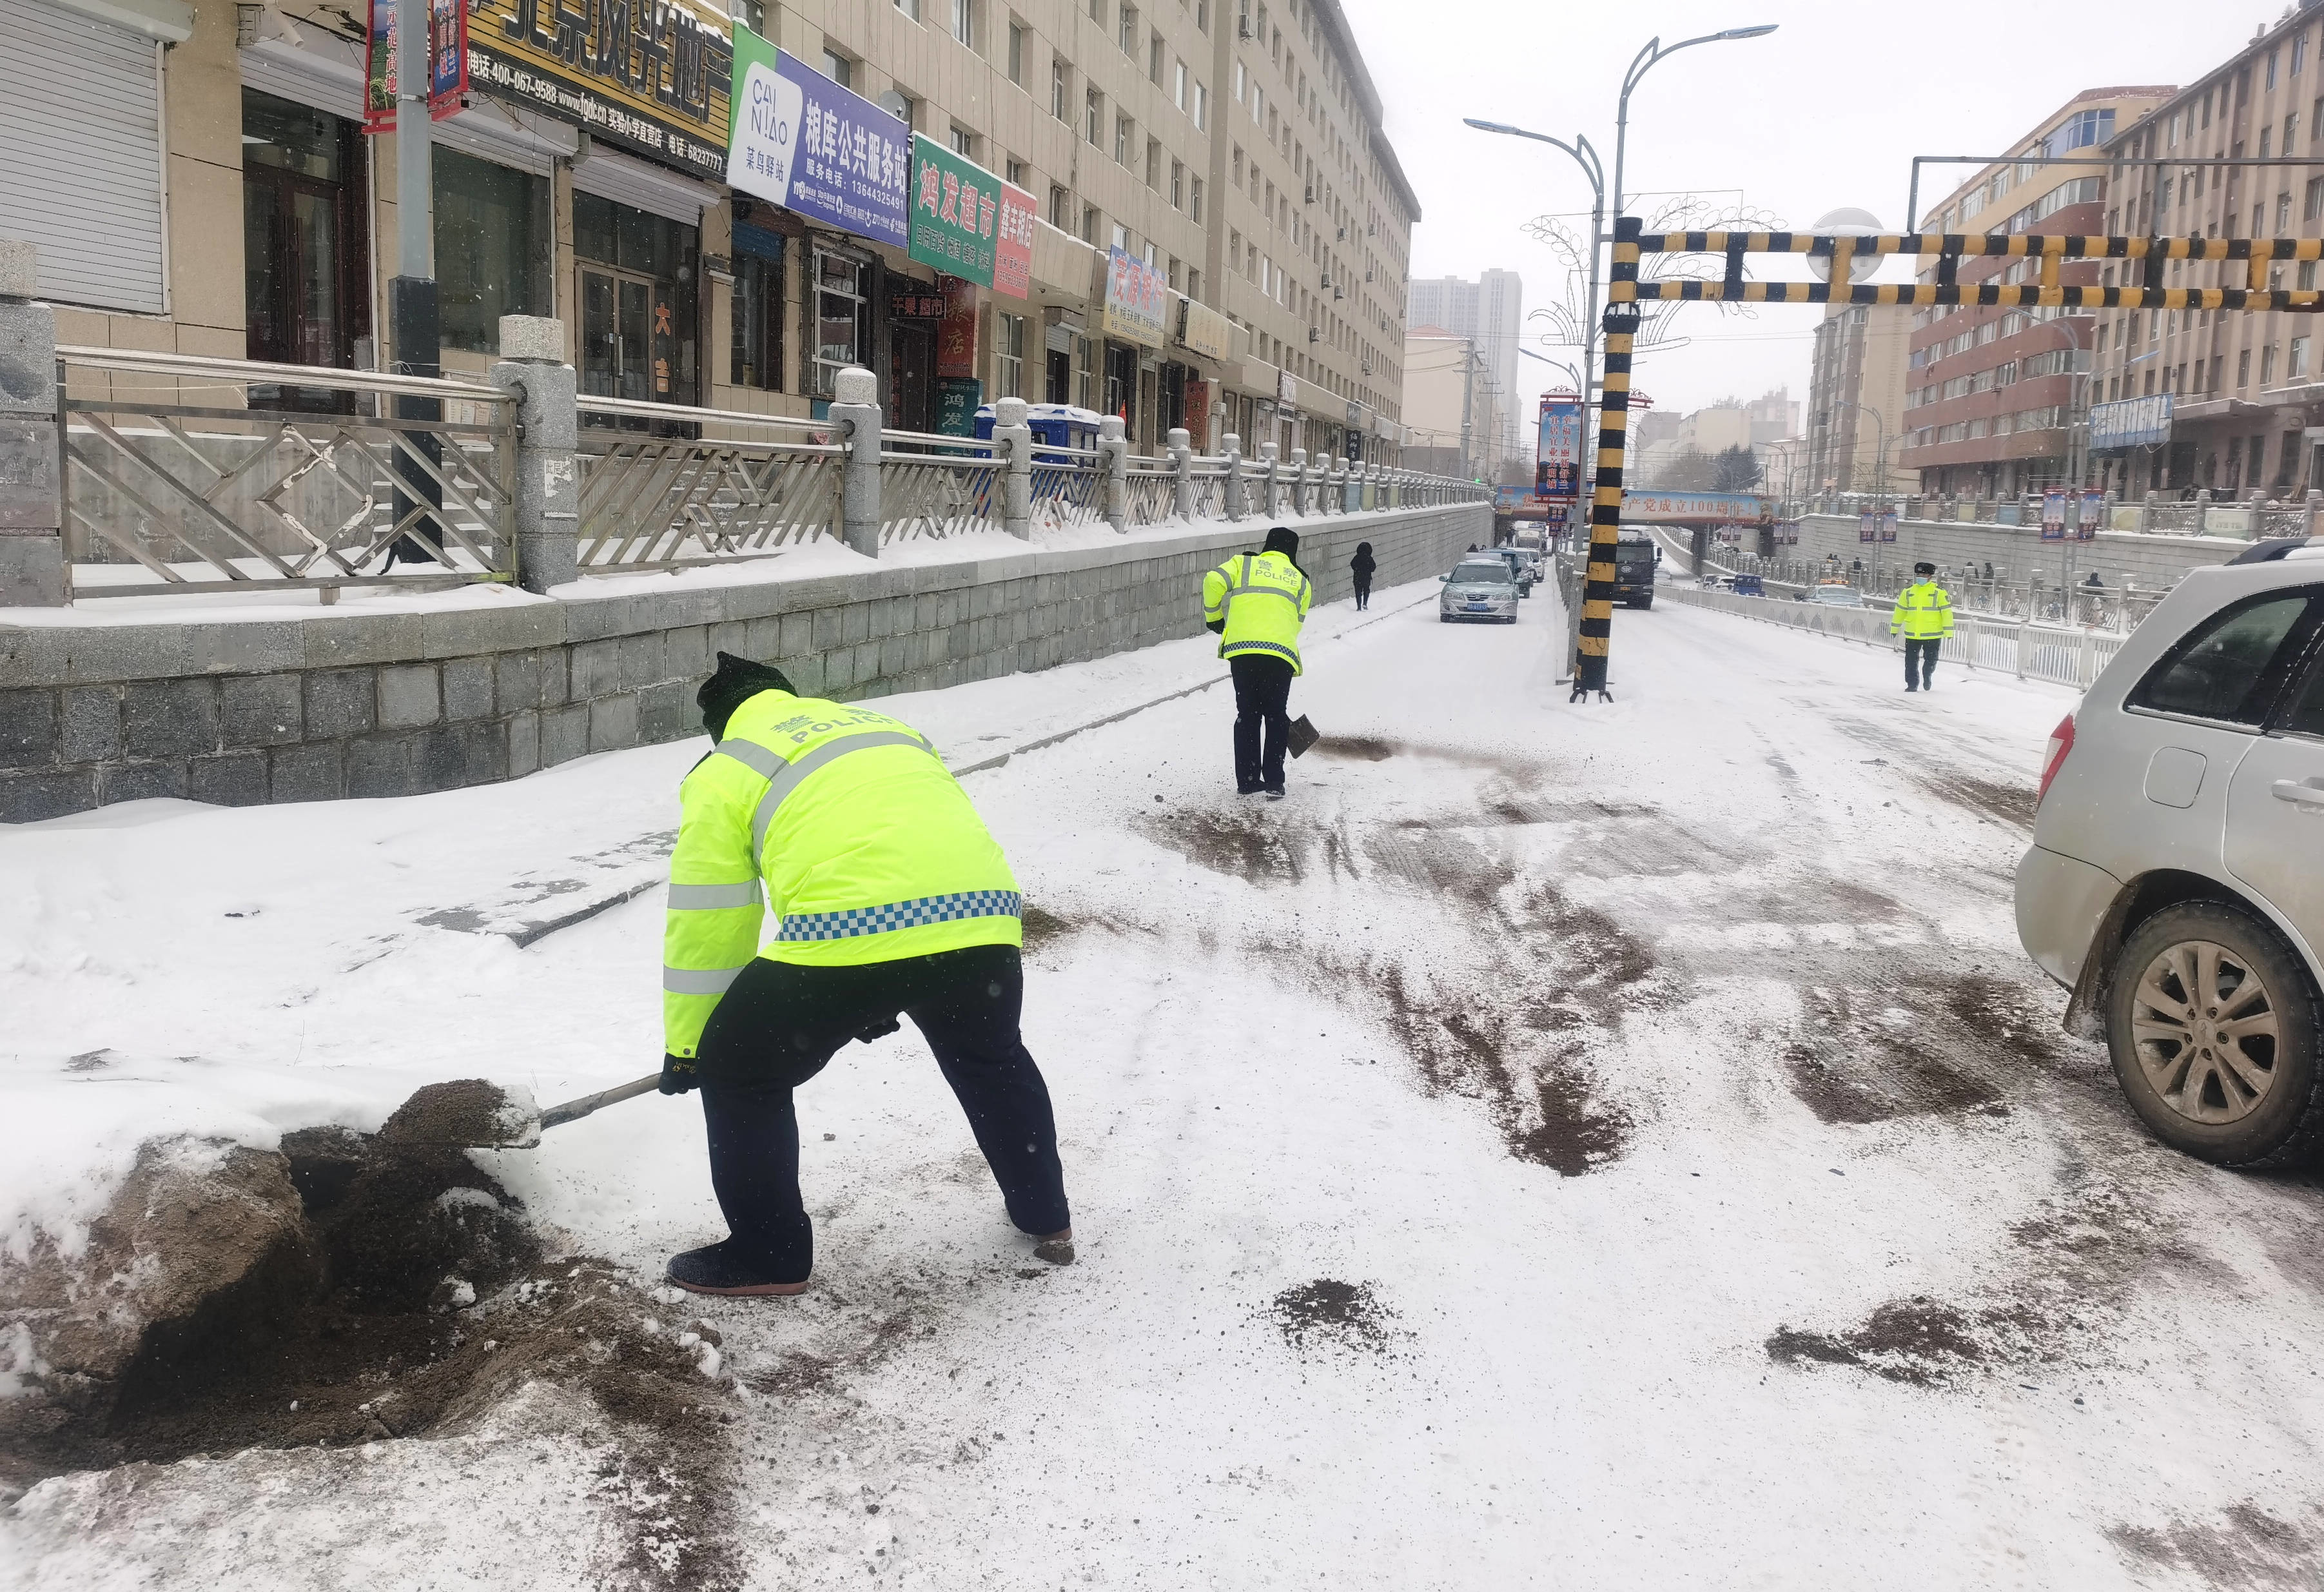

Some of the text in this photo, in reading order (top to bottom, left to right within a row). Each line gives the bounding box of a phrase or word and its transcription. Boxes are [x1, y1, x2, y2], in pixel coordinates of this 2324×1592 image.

[386, 0, 397, 94] 示范高地
[752, 79, 776, 113] CAI
[607, 108, 663, 149] 实验小学直营店
[806, 98, 906, 195] 粮库公共服务站
[746, 146, 784, 182] 菜鸟驿站
[919, 159, 995, 239] 鸿发超市
[917, 224, 944, 253] 日用百货
[1001, 198, 1033, 249] 鑫丰粮店
[919, 297, 942, 316] 超市
[656, 302, 671, 393] 大吉
[1547, 414, 1560, 489] 宜居宜业文明城
[1255, 569, 1298, 587] POLICE
